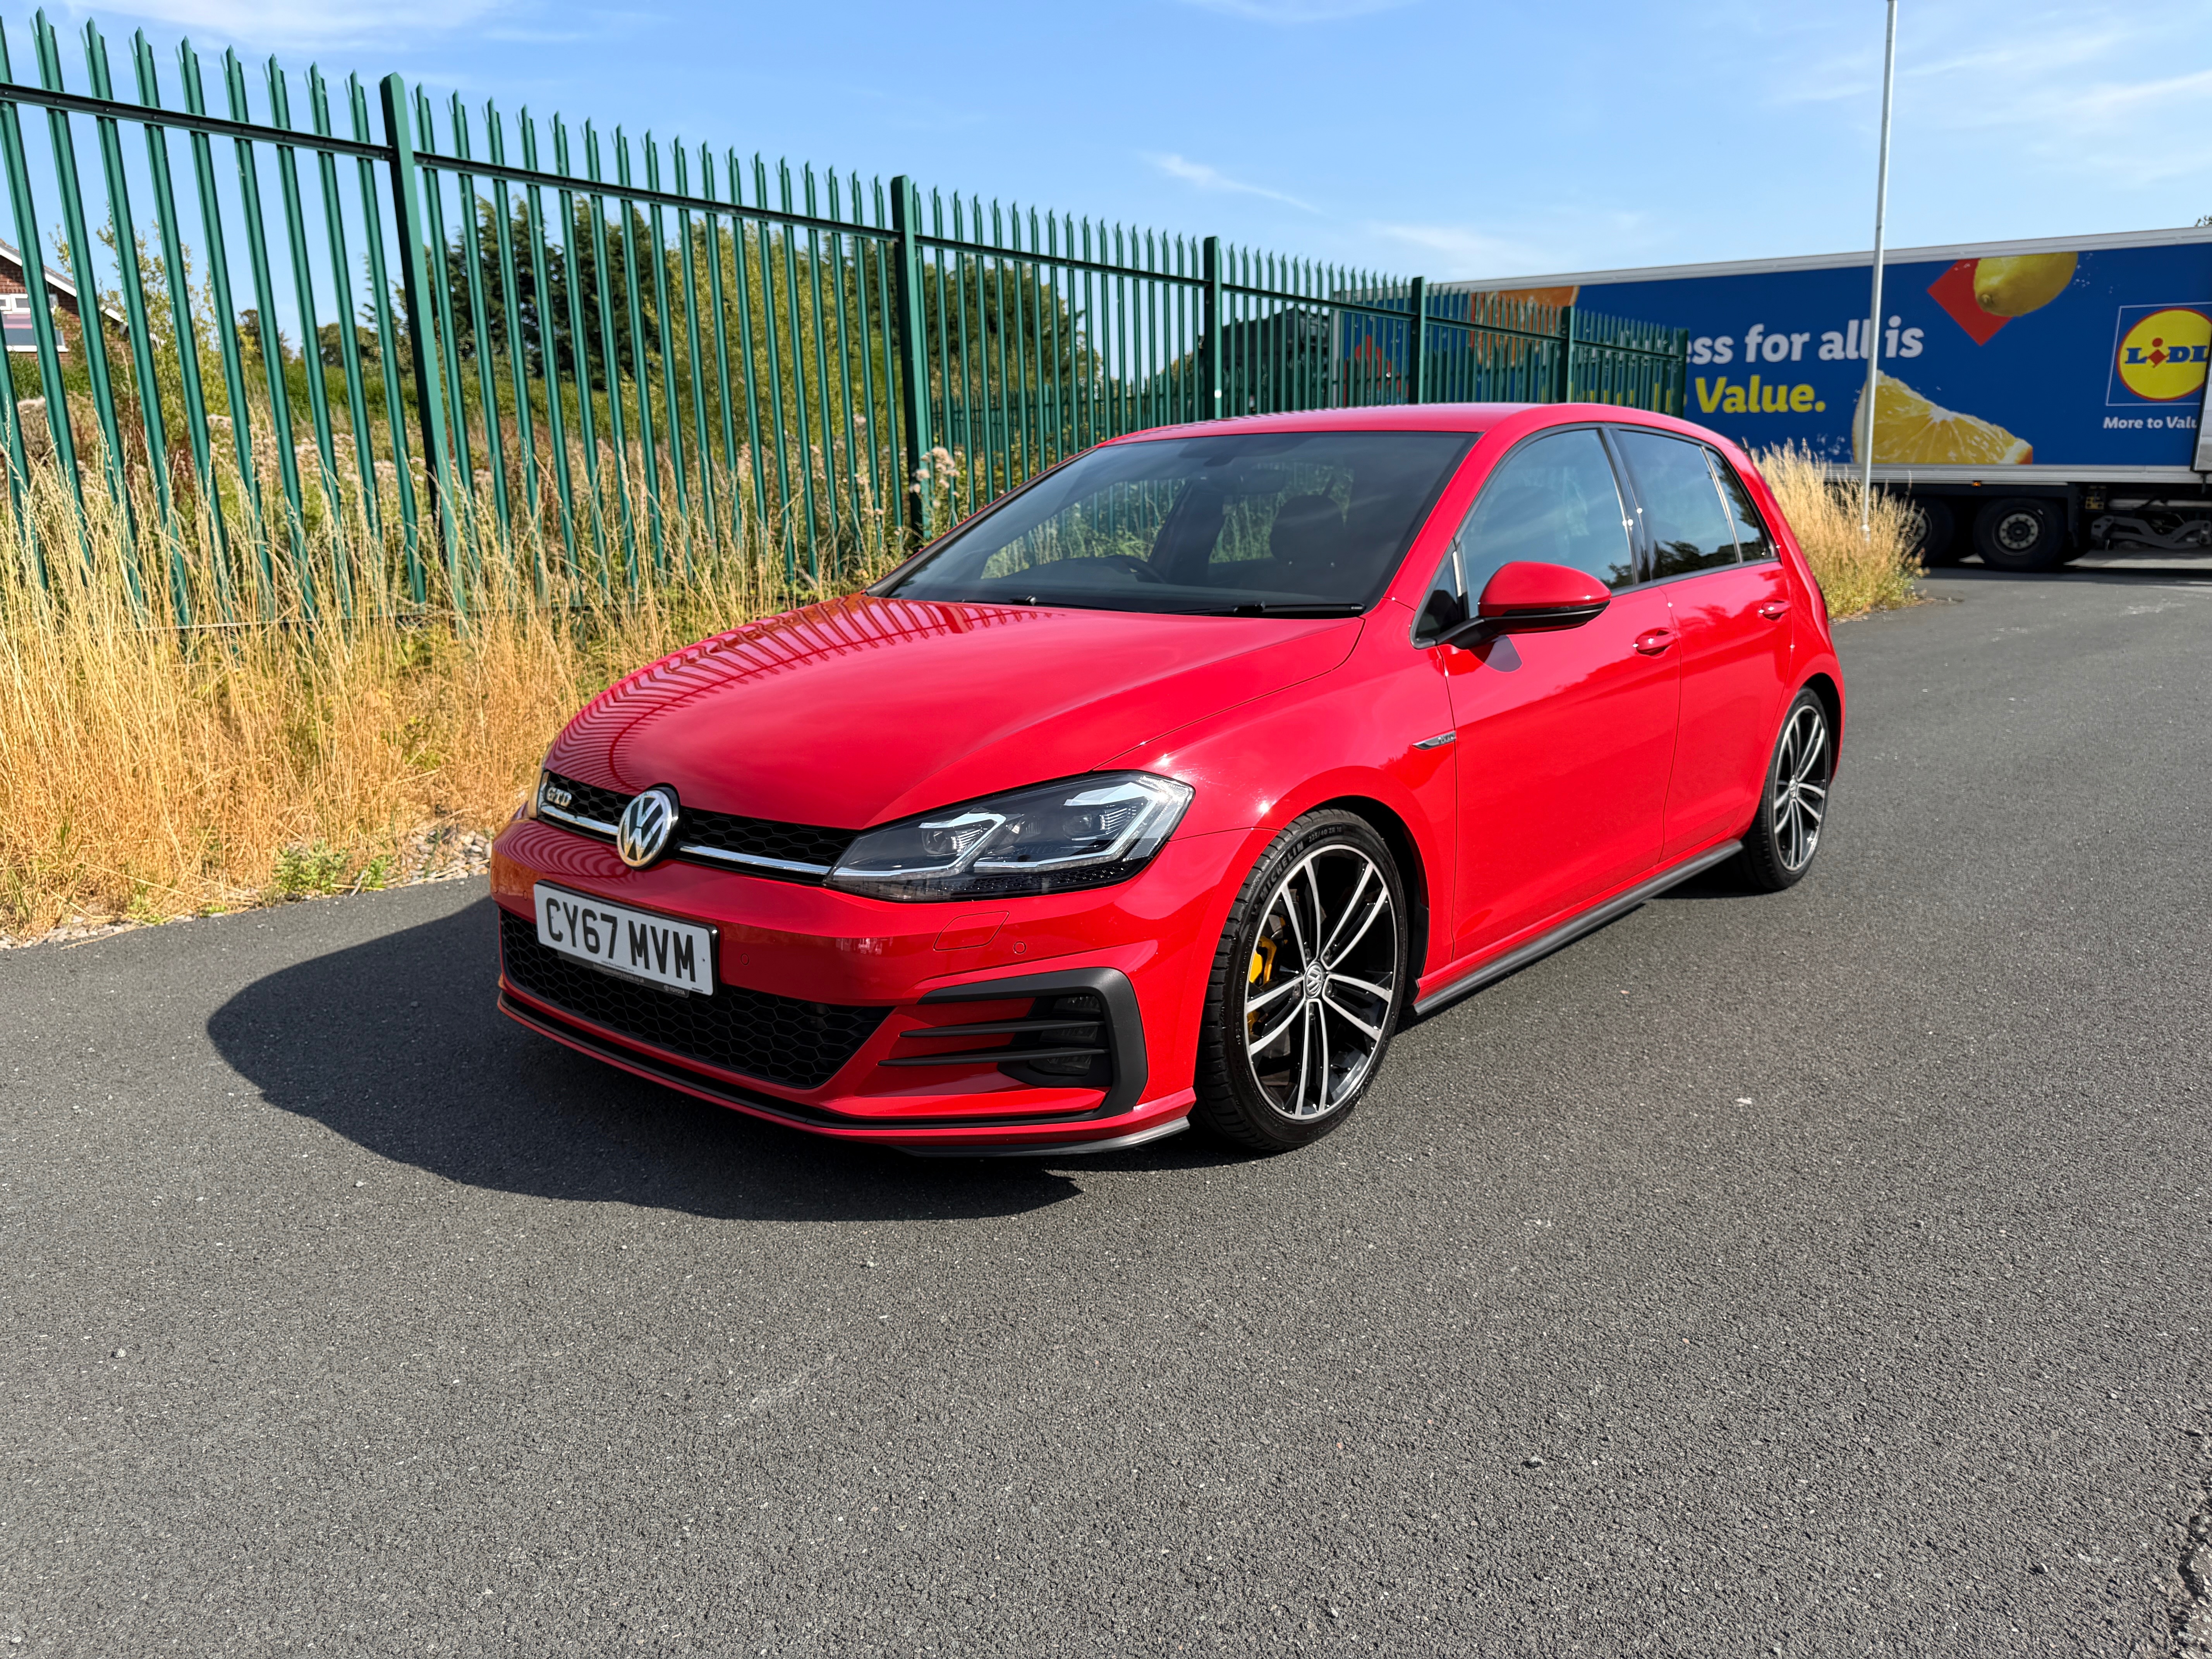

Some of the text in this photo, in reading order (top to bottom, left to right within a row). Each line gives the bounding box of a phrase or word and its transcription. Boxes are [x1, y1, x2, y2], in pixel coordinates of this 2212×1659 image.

[1744, 323, 1810, 362] for
[1818, 318, 1871, 361] all
[1885, 315, 1925, 358] is
[1695, 374, 1826, 413] Value.
[2103, 416, 2143, 429] More
[2147, 417, 2163, 429] to
[1260, 841, 1304, 902] MICHELIN
[546, 897, 696, 982] CY67 MVM
